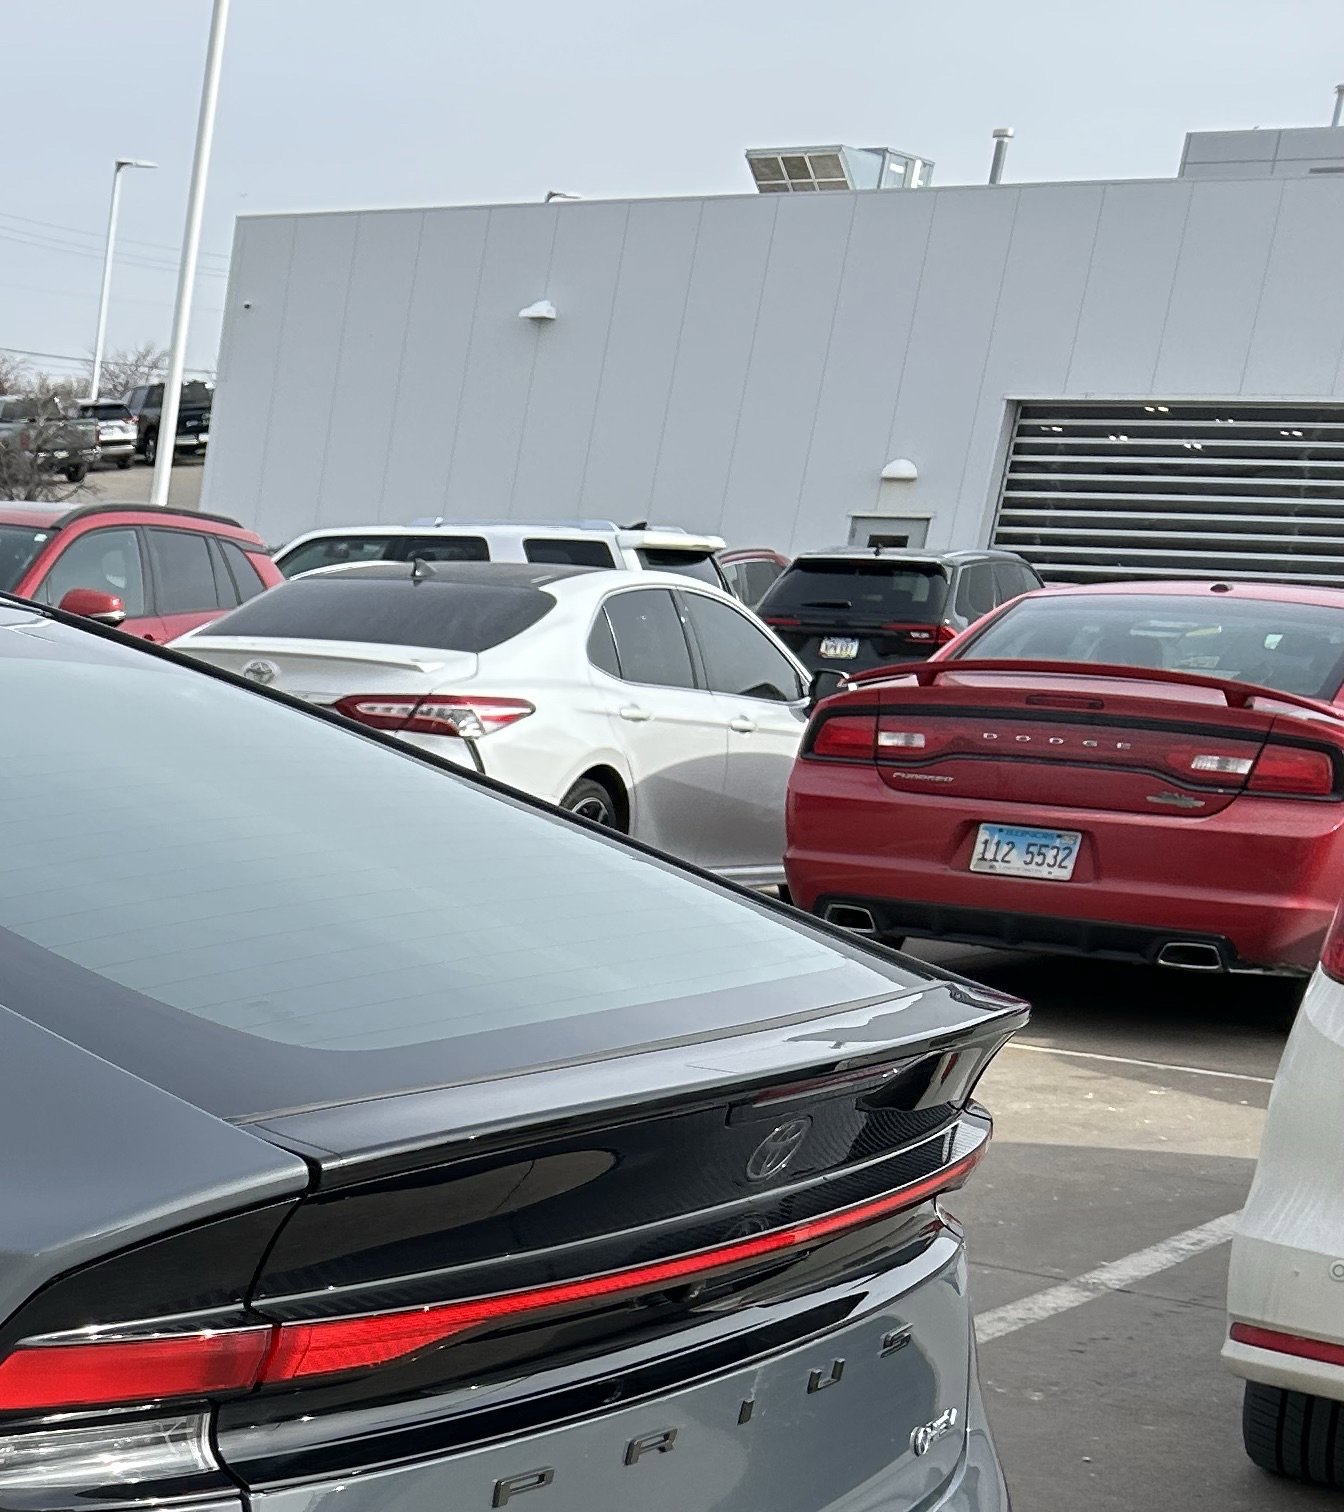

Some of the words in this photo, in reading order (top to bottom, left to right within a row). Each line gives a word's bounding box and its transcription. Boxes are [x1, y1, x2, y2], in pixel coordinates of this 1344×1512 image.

[977, 838, 1016, 864] 112
[1023, 842, 1073, 869] 5532
[491, 1322, 914, 1509] PRIUS
